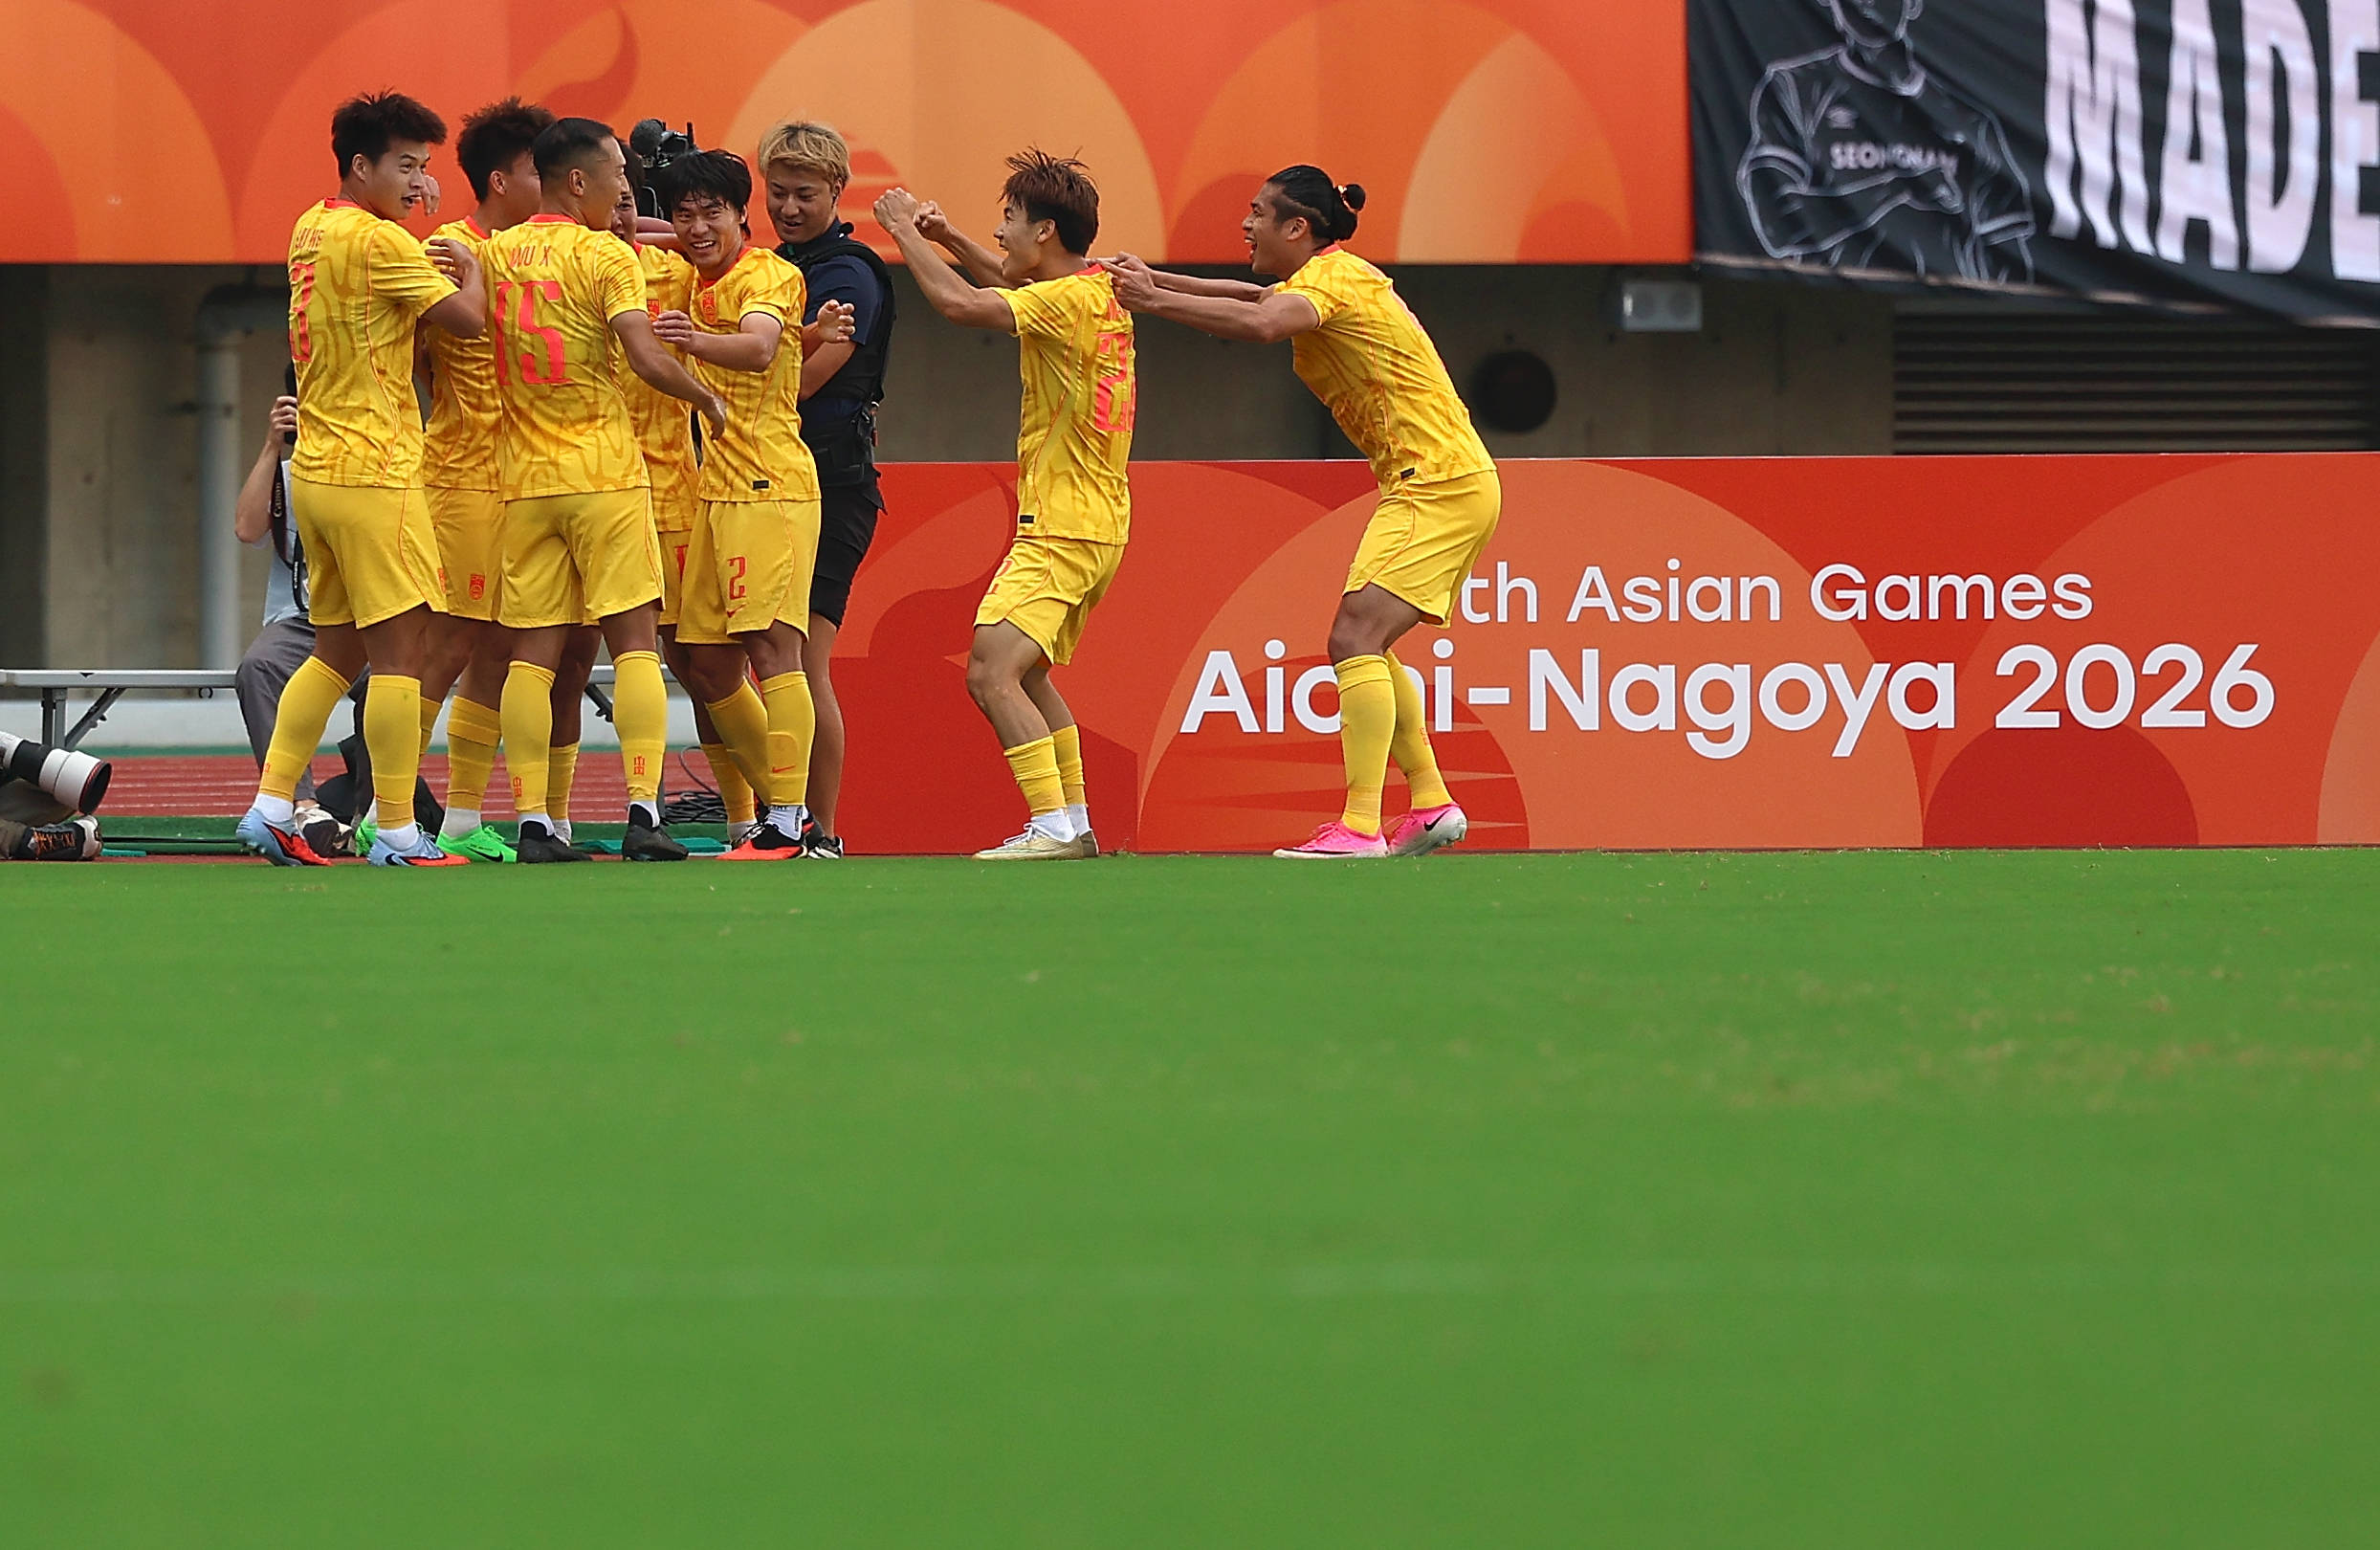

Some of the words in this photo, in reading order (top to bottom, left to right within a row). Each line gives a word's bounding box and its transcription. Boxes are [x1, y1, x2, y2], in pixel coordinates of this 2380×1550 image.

[2042, 0, 2380, 283] MADE
[494, 280, 576, 387] 15
[273, 481, 284, 518] Canon
[727, 556, 747, 601] 2
[1461, 561, 1537, 624] th
[1566, 558, 1780, 623] Asian
[1810, 564, 2093, 622] Games
[1179, 638, 1956, 760] Aici-Nagoya
[1995, 643, 2276, 729] 2026
